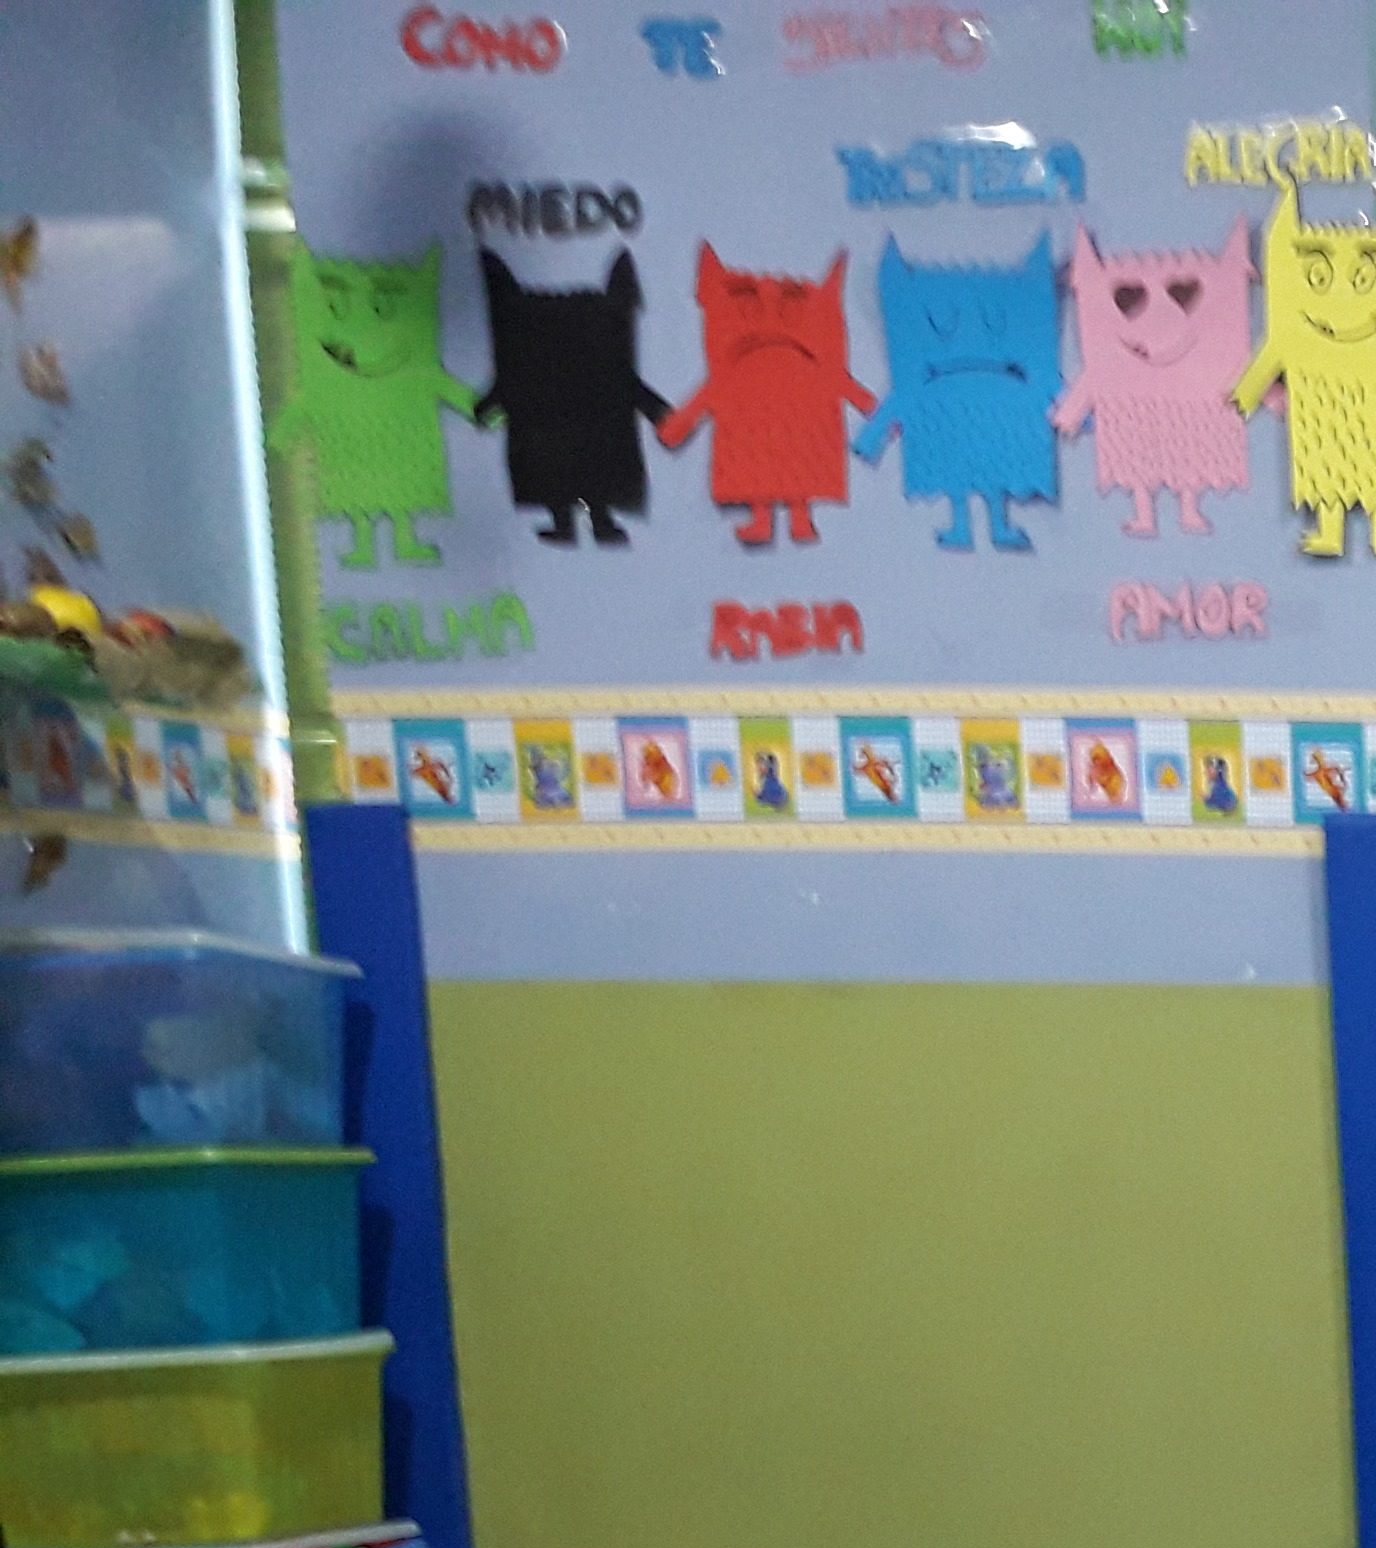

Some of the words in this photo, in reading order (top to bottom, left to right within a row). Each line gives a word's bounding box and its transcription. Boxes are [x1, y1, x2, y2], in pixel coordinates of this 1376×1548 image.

[400, 2, 568, 73] COMO
[640, 16, 726, 79] TE
[1184, 113, 1376, 187] ALEGRIA
[466, 180, 644, 237] MIEDO
[325, 588, 534, 666] CALMA
[1108, 579, 1269, 642] AMOR
